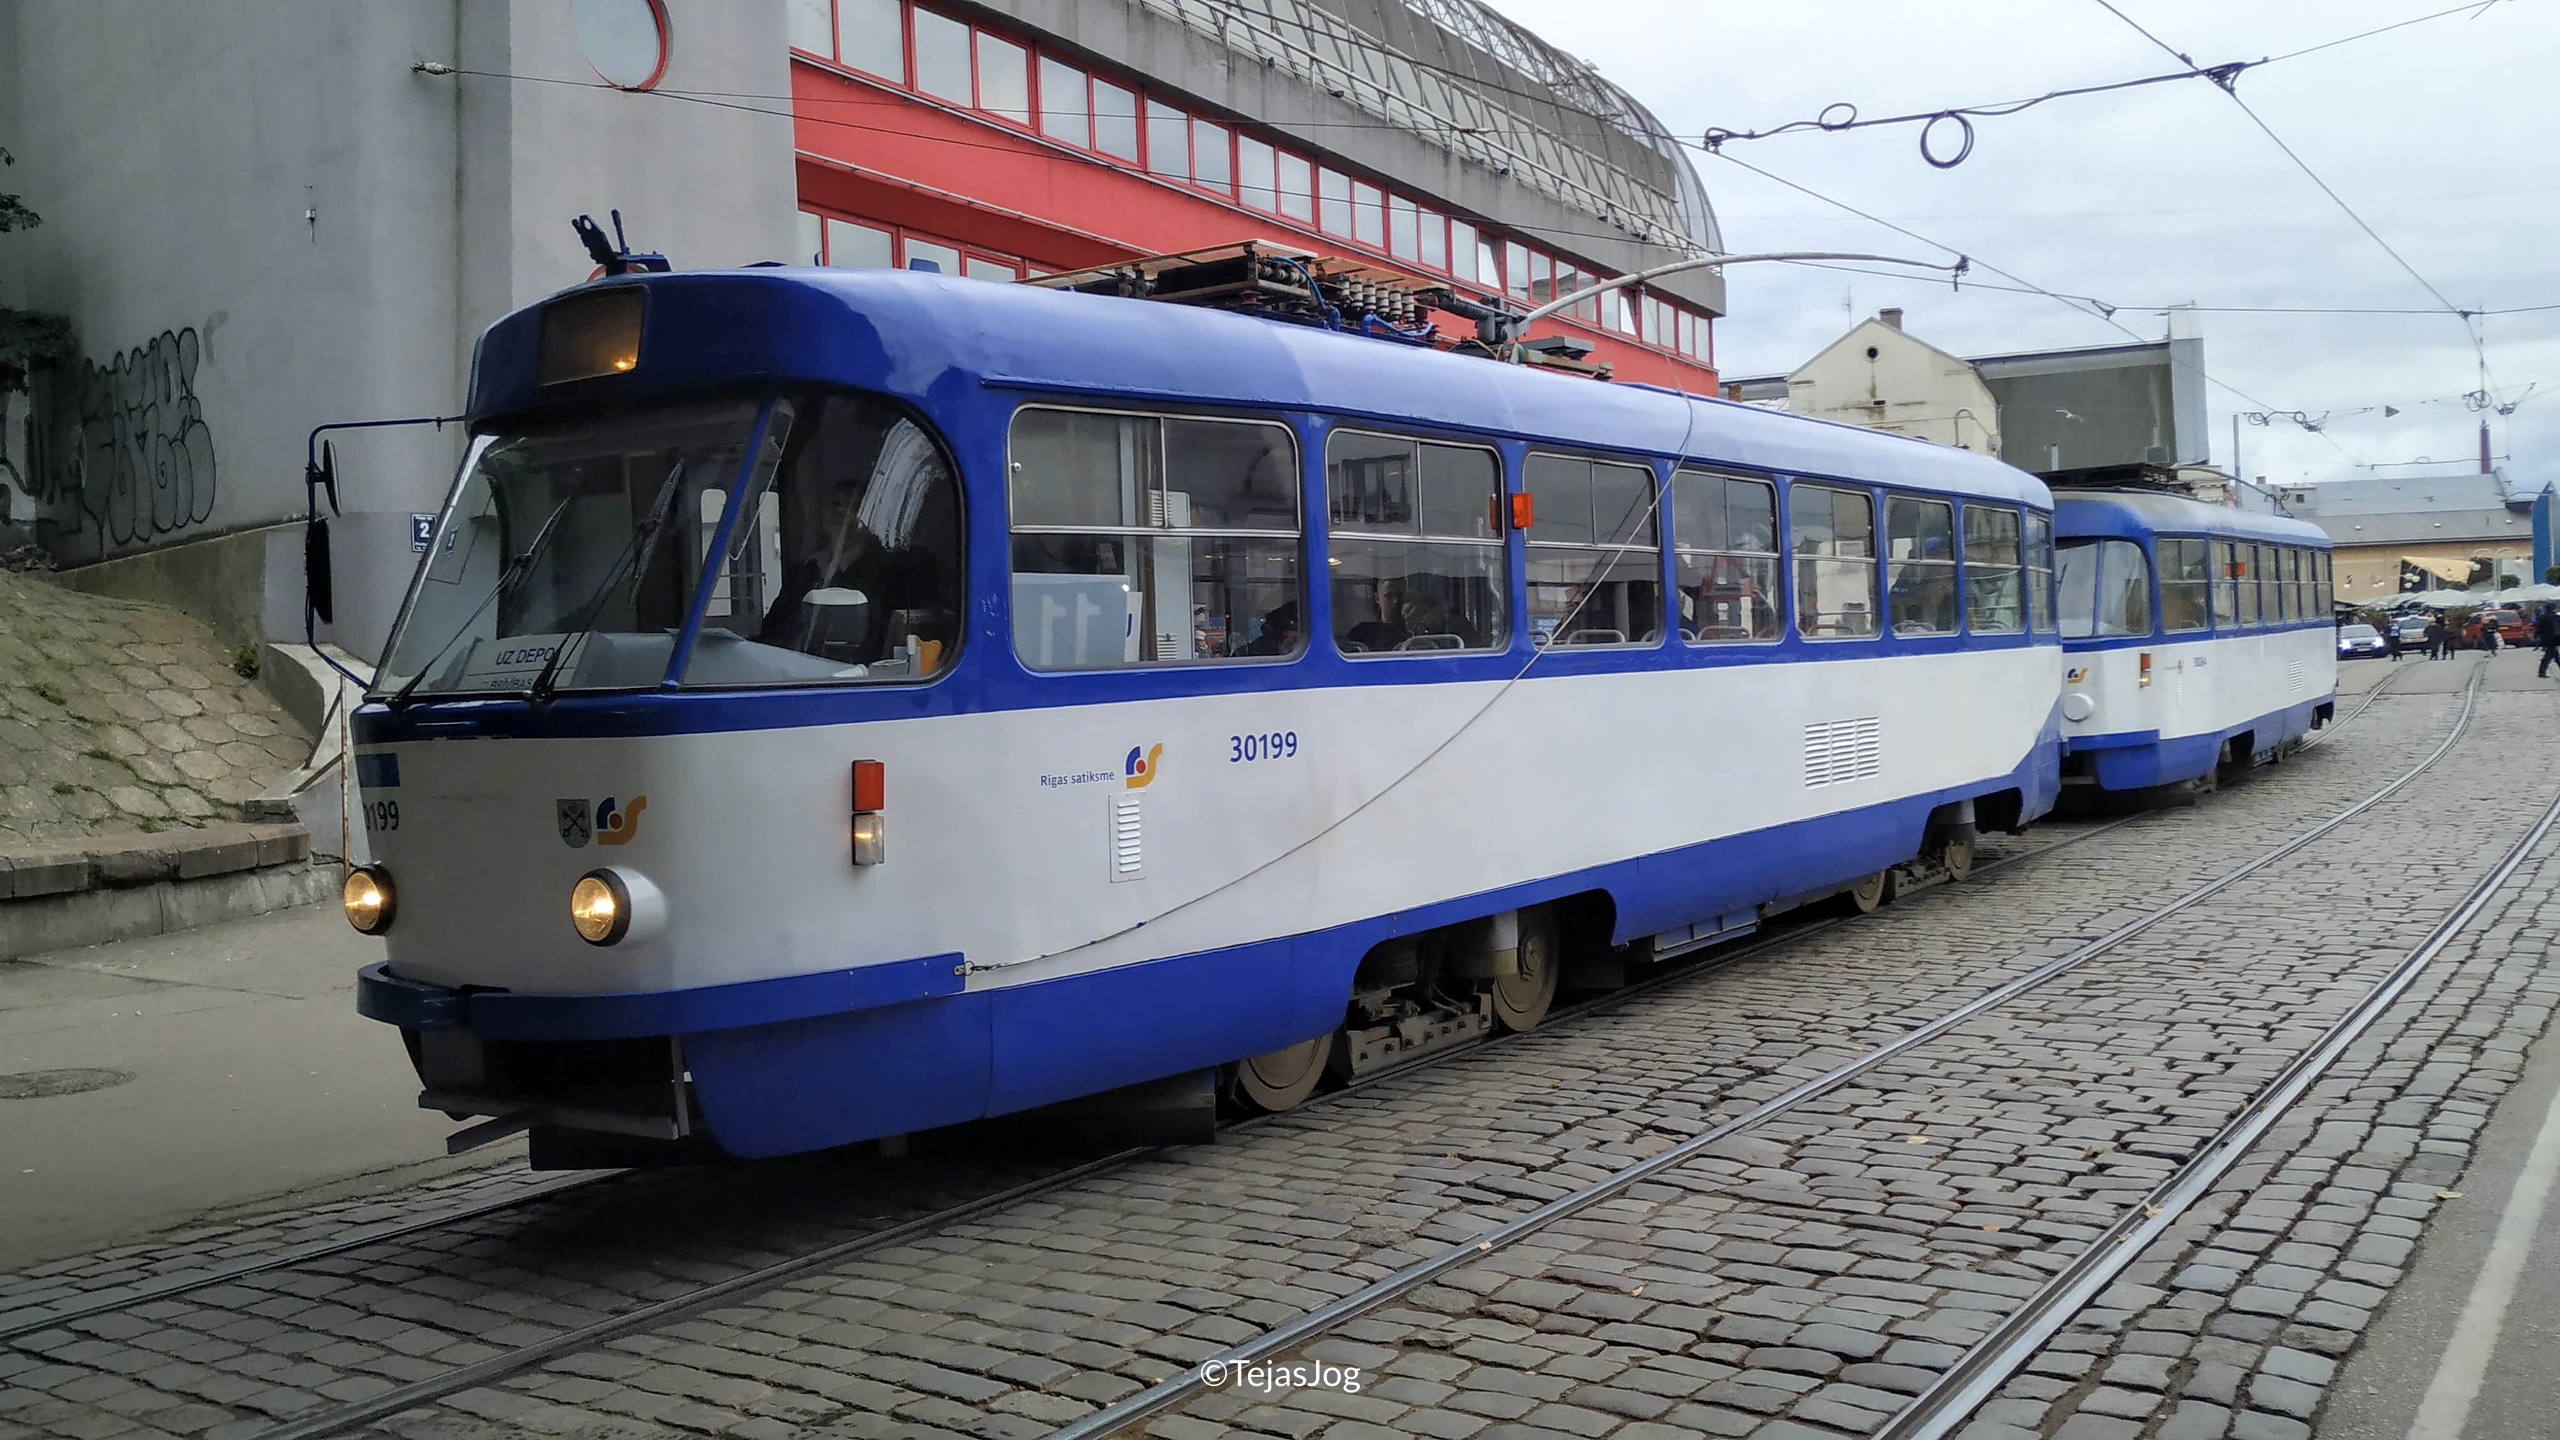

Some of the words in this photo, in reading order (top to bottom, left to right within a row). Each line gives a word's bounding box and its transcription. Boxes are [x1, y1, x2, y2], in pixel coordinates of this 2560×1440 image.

[419, 522, 430, 538] 2
[496, 650, 516, 666] UZ
[515, 647, 556, 664] DEPO
[1229, 731, 1298, 763] 30199
[1040, 774, 1068, 789] Rīgas
[1070, 771, 1115, 785] satiksme
